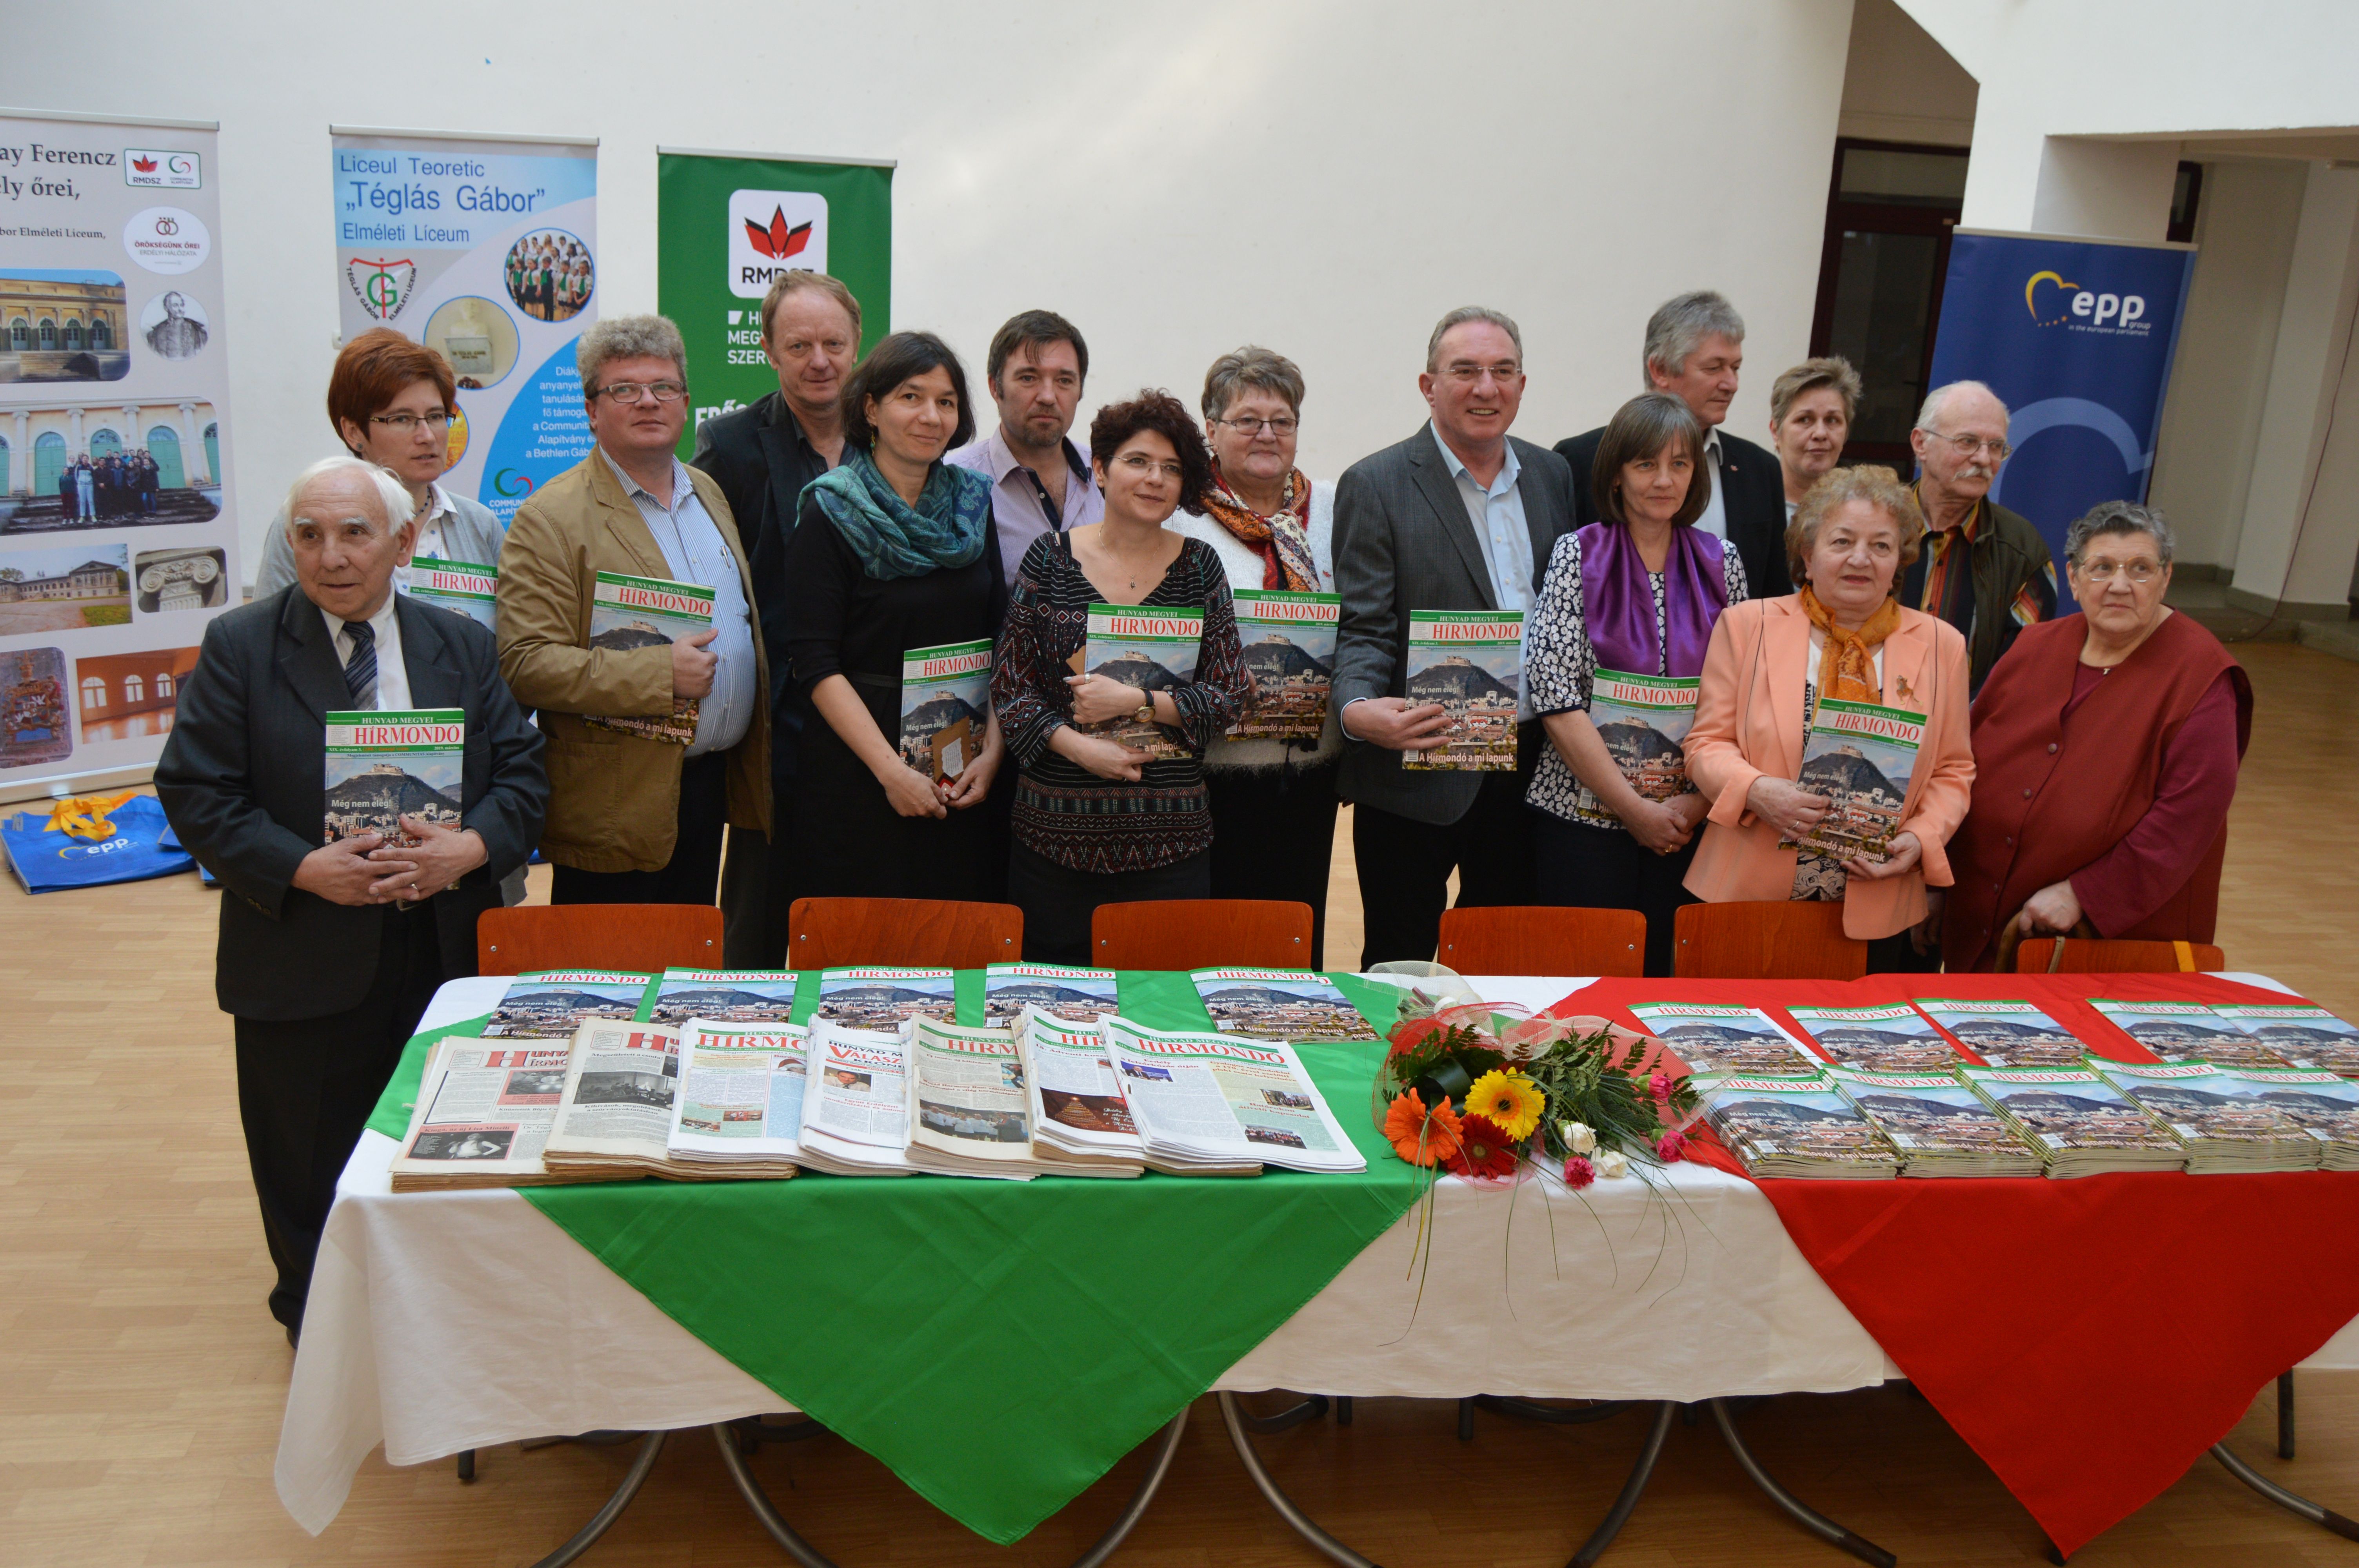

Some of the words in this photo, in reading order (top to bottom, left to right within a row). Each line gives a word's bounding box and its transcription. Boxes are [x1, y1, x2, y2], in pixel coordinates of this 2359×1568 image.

[31, 144, 116, 165] Ferencz
[341, 155, 396, 173] Liceul
[409, 158, 485, 177] Teoretic
[31, 177, 80, 200] őrei,
[346, 181, 440, 215] „Téglás
[456, 185, 545, 212] Gábor”
[20, 227, 62, 237] Elméleti
[343, 223, 405, 241] Elméleti
[2072, 291, 2145, 328] epp
[2087, 326, 2115, 334] european
[2117, 328, 2149, 337] parliament
[2129, 321, 2151, 330] group
[727, 350, 771, 365] SZER
[538, 434, 585, 445] Alapítvány
[534, 448, 569, 457] Bethlen
[439, 564, 466, 572] HUNYAD
[627, 580, 658, 590] HUNYAD
[659, 585, 689, 595] MEGYEI
[619, 588, 711, 615] HÍRMONDÓ
[1254, 602, 1337, 620] HÍRMONDÓ
[1110, 618, 1199, 635] HÍRMONDÓ
[1432, 623, 1519, 640] HÍRMONDÓ
[929, 650, 953, 659] HUNYAD
[954, 647, 976, 656] MEGYEI
[923, 652, 990, 676] HÍRMONDÓ
[1620, 677, 1649, 686] HUNYAD
[1412, 686, 1427, 695] Még
[1443, 686, 1459, 694] elég!
[1613, 684, 1696, 704] HÍRMONDÓ
[1845, 706, 1872, 714] HUNYAD
[1872, 710, 1900, 720] MEGYEI
[664, 725, 693, 738] lapunk
[906, 723, 919, 732] Még
[934, 720, 947, 729] elég!
[1243, 724, 1277, 733] Hírmondó
[1295, 724, 1319, 733] lapunk
[1835, 713, 1919, 741] HÍRMONDÓ
[354, 725, 460, 744] HÍRMONDÓ
[1151, 742, 1160, 751] mi
[1419, 753, 1425, 762] A
[1427, 752, 1467, 763] Hírmondó
[1475, 753, 1485, 762] mi
[1486, 752, 1514, 764] lapunk
[1803, 771, 1816, 780] Még
[332, 800, 350, 809] Még
[371, 799, 391, 809] elég!
[87, 838, 129, 855] epp
[1845, 844, 1856, 855] mi
[1857, 847, 1886, 862] lapunk
[511, 1030, 562, 1038] Hírmondó
[1244, 1025, 1290, 1033] Hírmondó
[829, 1041, 885, 1054] HUNYAD
[1138, 1038, 1285, 1064] HÍRMONDÓ
[1788, 1147, 1836, 1158] Hírmondó
[1859, 1151, 1896, 1160] lapunk
[1923, 1141, 1975, 1151] Hírmondó
[1996, 1145, 2031, 1153] lapunk
